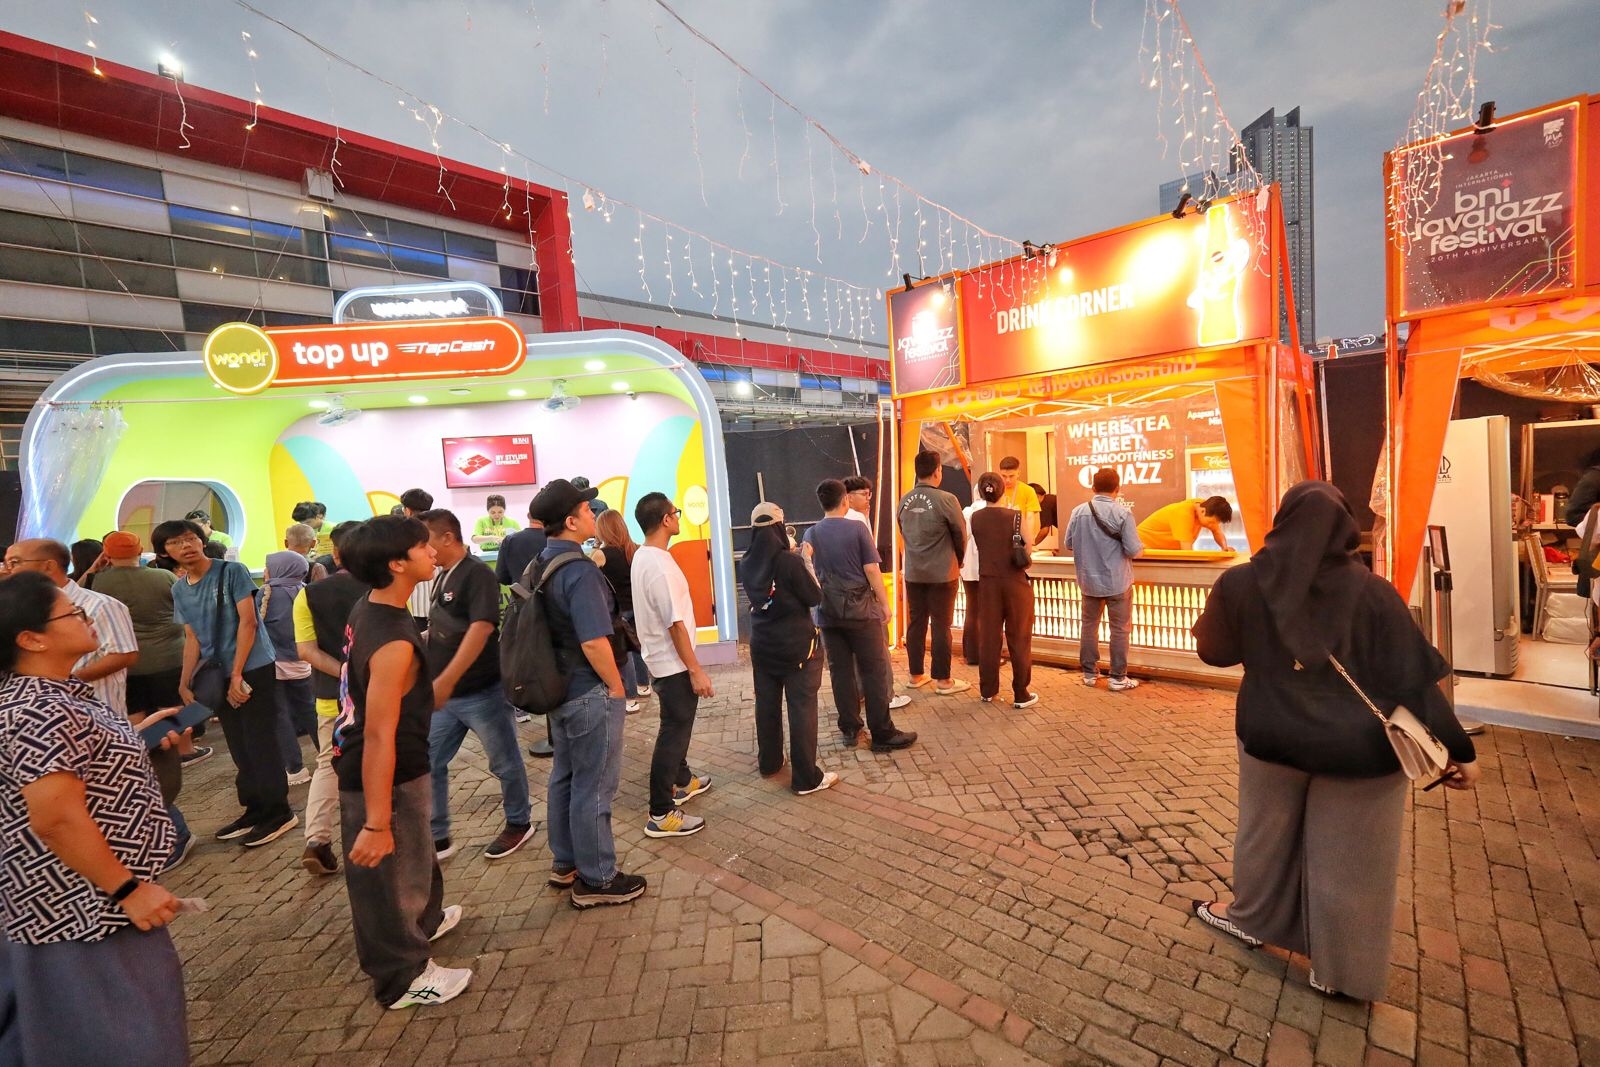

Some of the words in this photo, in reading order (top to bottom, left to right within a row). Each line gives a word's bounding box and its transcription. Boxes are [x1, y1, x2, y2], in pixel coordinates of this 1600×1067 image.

[1456, 172, 1513, 189] INTERNATIONAL
[1466, 170, 1498, 182] JAKARTA
[1455, 179, 1512, 213] bni
[1412, 192, 1563, 241] javajazz
[1431, 214, 1546, 255] festival
[1431, 252, 1458, 263] 20TH
[1463, 235, 1546, 257] ANNIVERSARY
[997, 299, 1051, 334] DRINK
[1054, 283, 1136, 321] CORNER
[212, 348, 269, 366] wondr
[292, 342, 344, 369] top
[351, 342, 389, 367] up
[416, 339, 495, 356] TapCash
[1067, 419, 1132, 439] WHERE
[1134, 415, 1171, 433] TEA
[1091, 434, 1144, 454] MEET
[1066, 456, 1089, 466] THE
[1090, 449, 1175, 465] SMOOTHNESS
[1116, 461, 1162, 487] JAZZ
